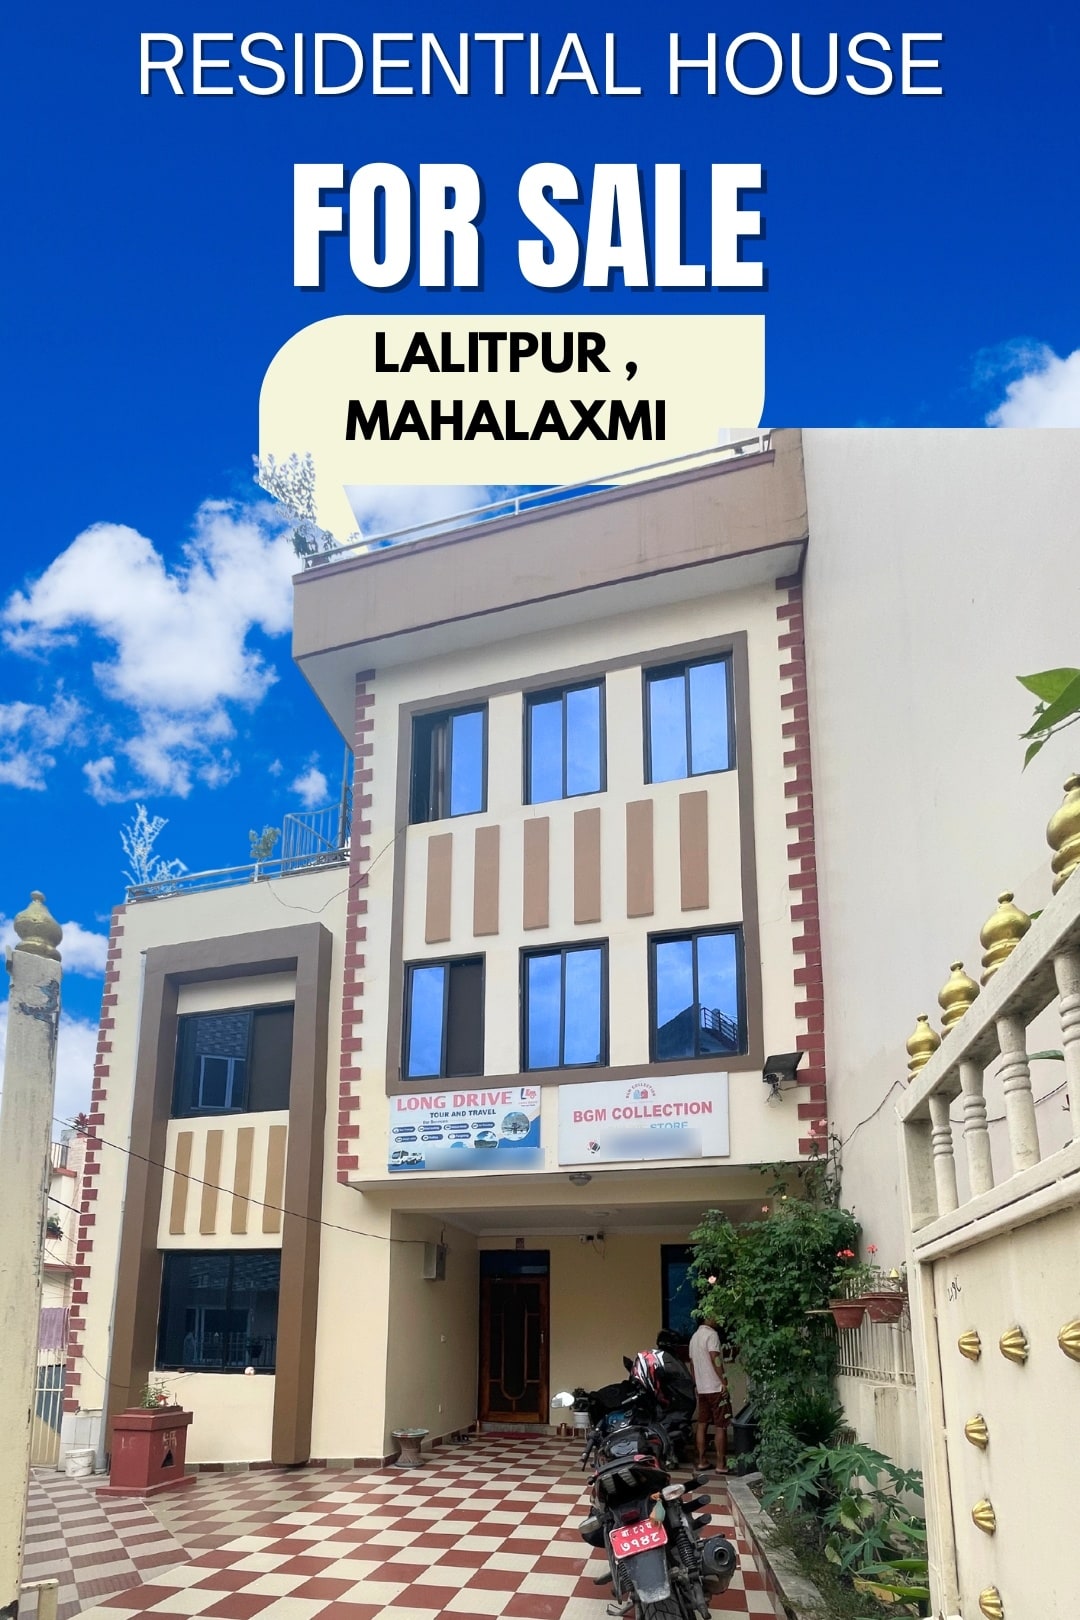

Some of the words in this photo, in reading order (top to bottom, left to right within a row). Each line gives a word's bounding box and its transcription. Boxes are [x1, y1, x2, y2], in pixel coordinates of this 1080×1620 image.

[397, 1096, 446, 1111] LONG
[453, 1091, 512, 1108] DRIVE
[468, 1108, 496, 1116] TRAVEL
[573, 1109, 606, 1123] BGM
[612, 1101, 712, 1120] COLLECTION
[620, 1532, 660, 1551] ७१४८
